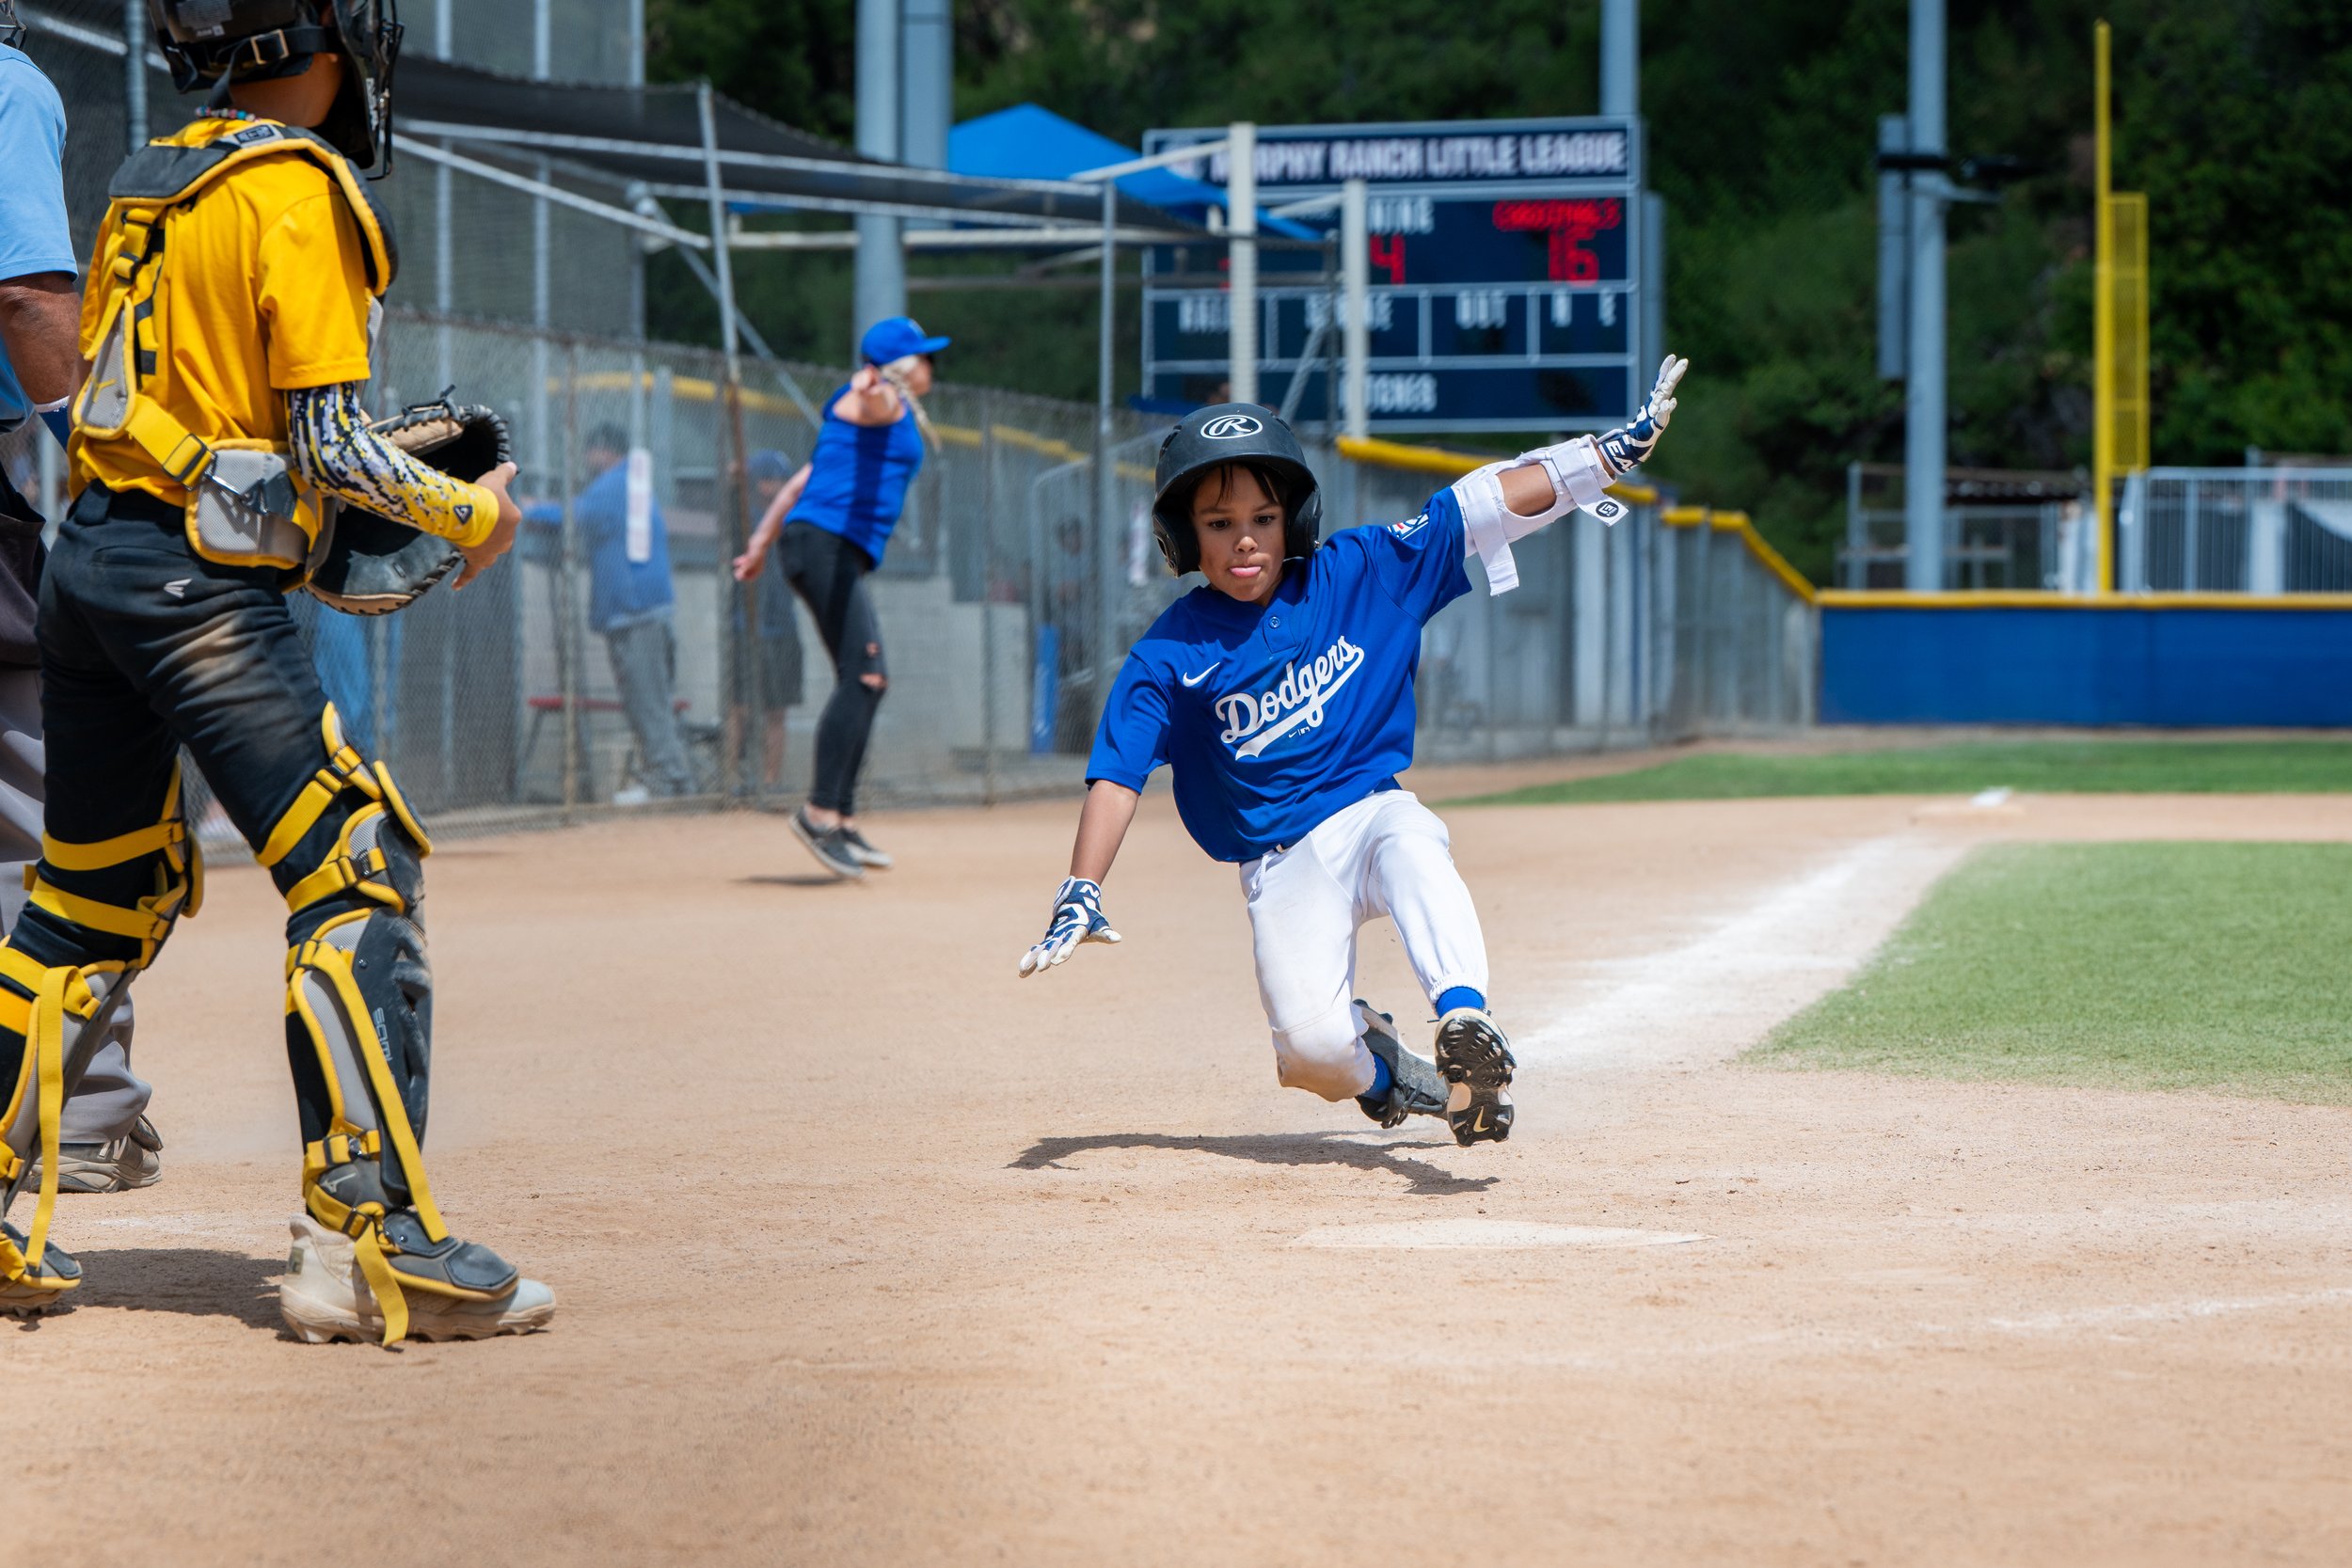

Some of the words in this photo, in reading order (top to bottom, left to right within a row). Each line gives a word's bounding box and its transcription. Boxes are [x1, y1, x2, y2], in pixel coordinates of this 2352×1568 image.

[1210, 142, 1327, 182] MRPHY
[1329, 138, 1423, 180] RANCH
[1426, 135, 1518, 177] LITTLE
[1519, 132, 1626, 175] LEAGUE
[1367, 197, 1435, 235] NING
[1370, 232, 1406, 285] 4
[1605, 440, 1637, 471] EA
[1215, 635, 1360, 745] Dodgers
